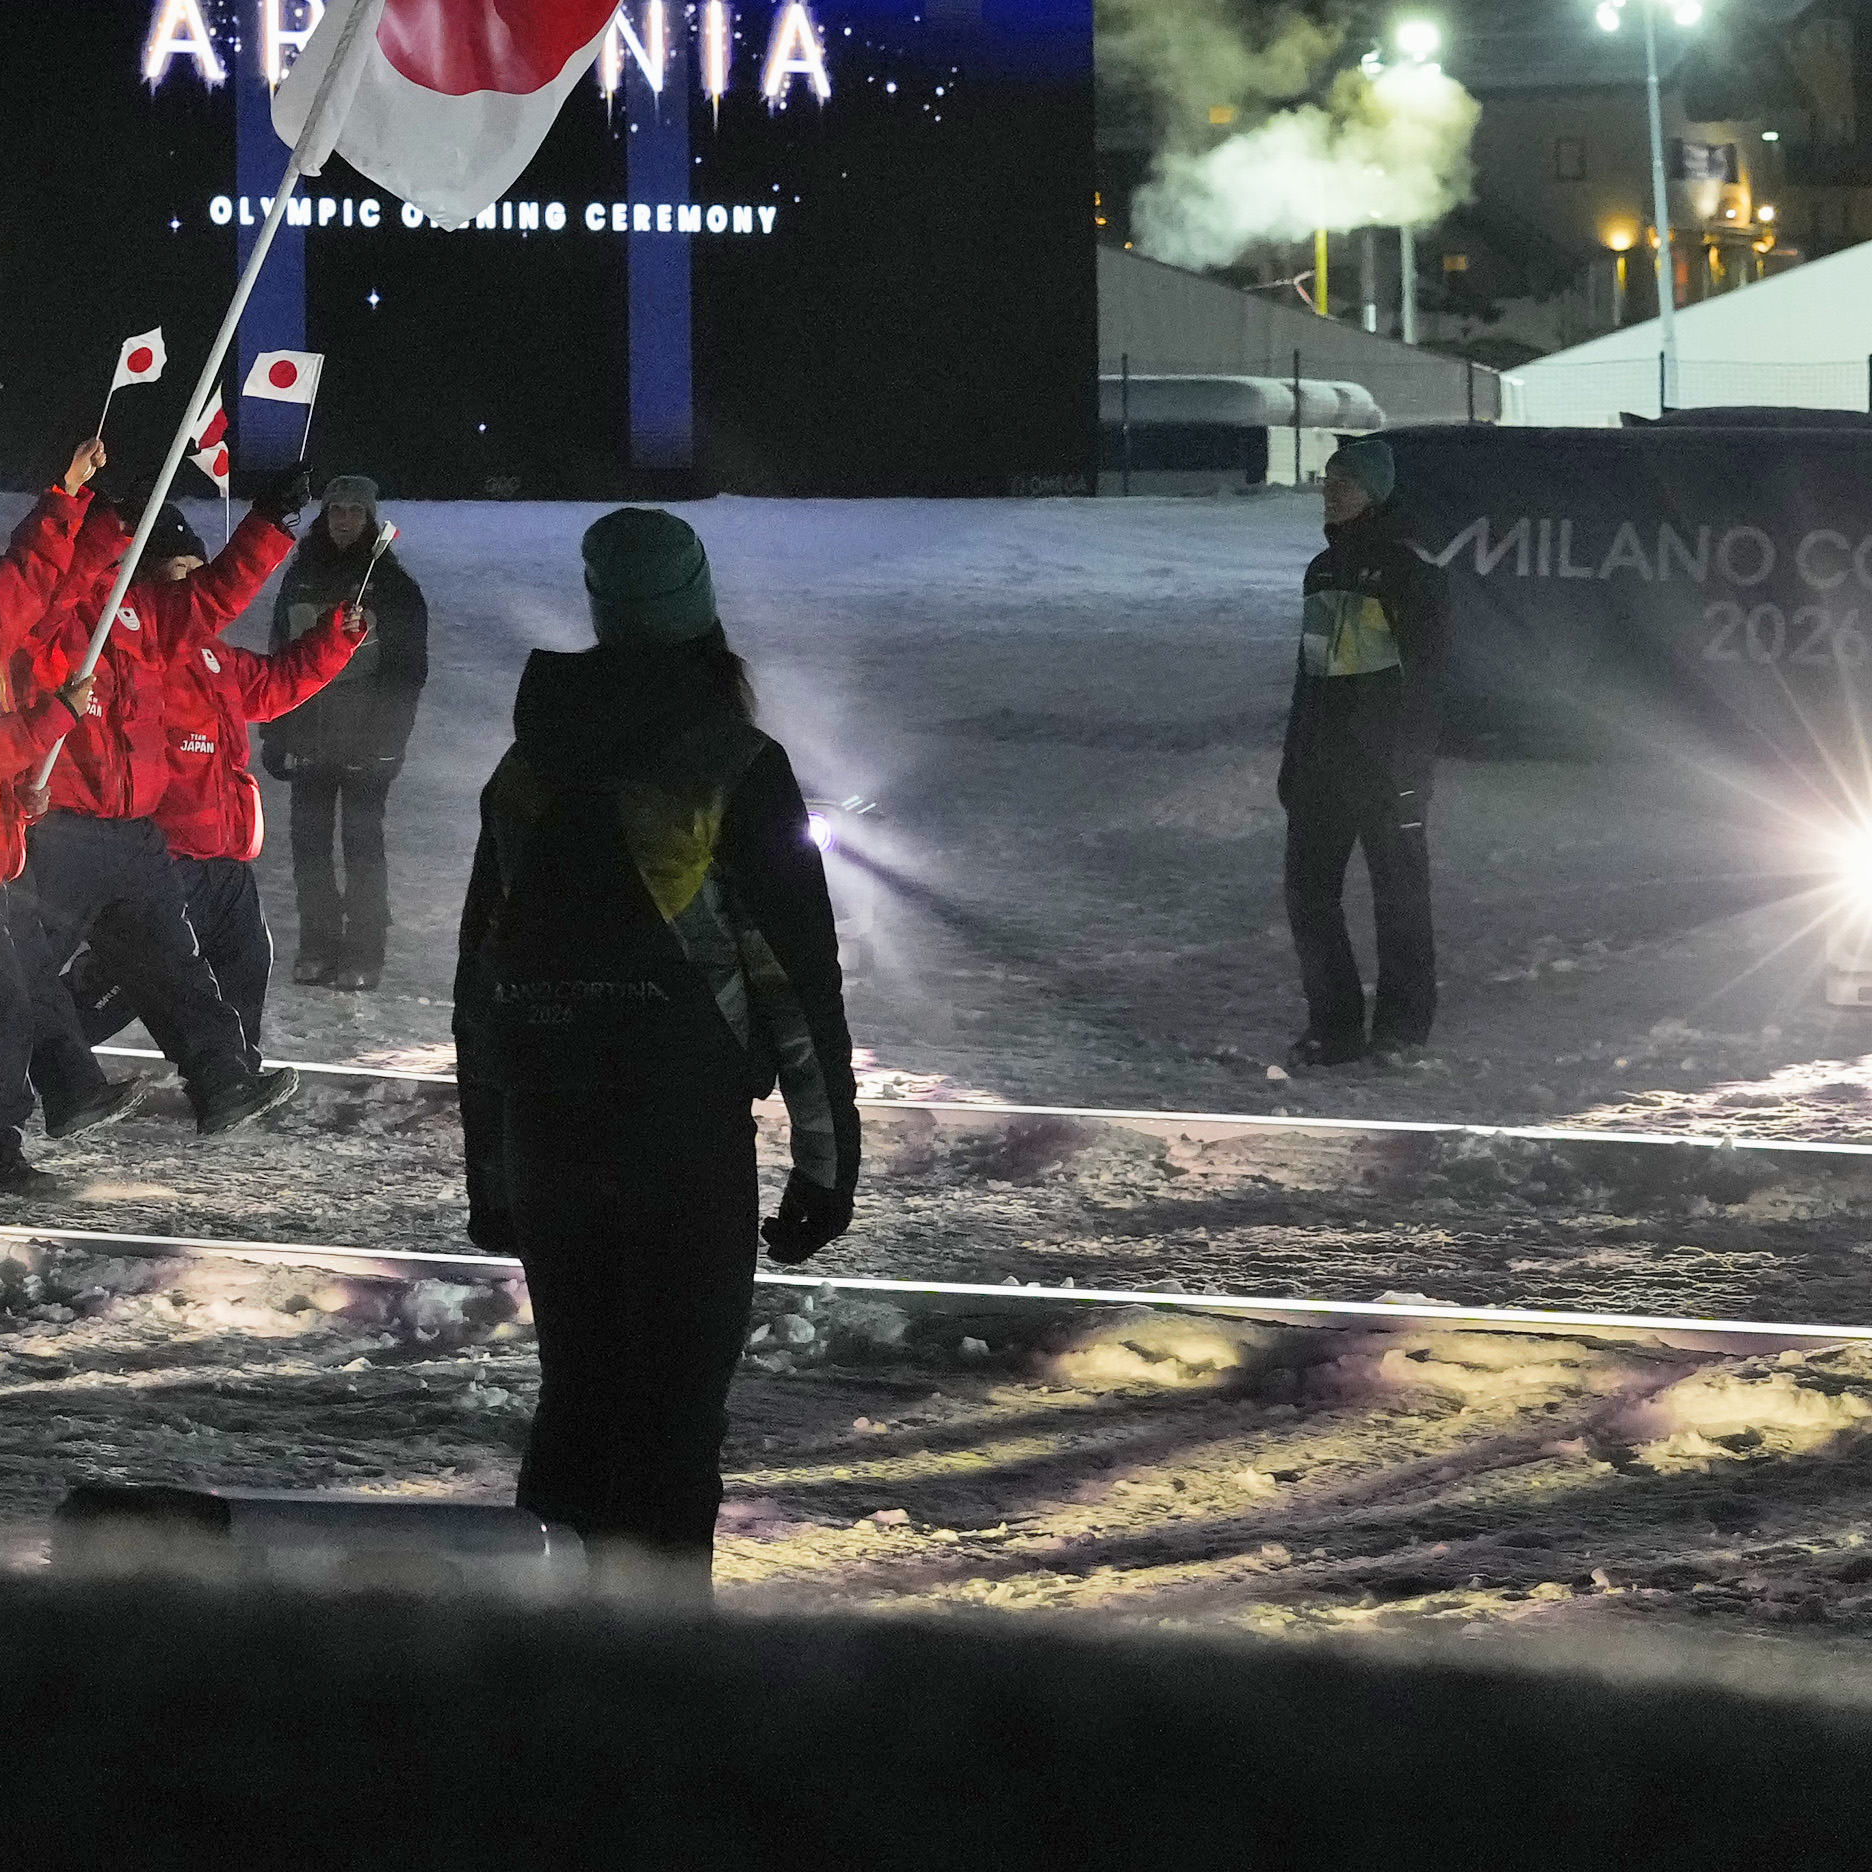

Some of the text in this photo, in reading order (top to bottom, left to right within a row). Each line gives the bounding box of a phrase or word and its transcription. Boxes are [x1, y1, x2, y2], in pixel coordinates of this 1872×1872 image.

[400, 201, 567, 231] ONING
[585, 203, 778, 234] CEREMONY
[1401, 516, 1776, 587] MILANO
[180, 740, 215, 754] JAPAN
